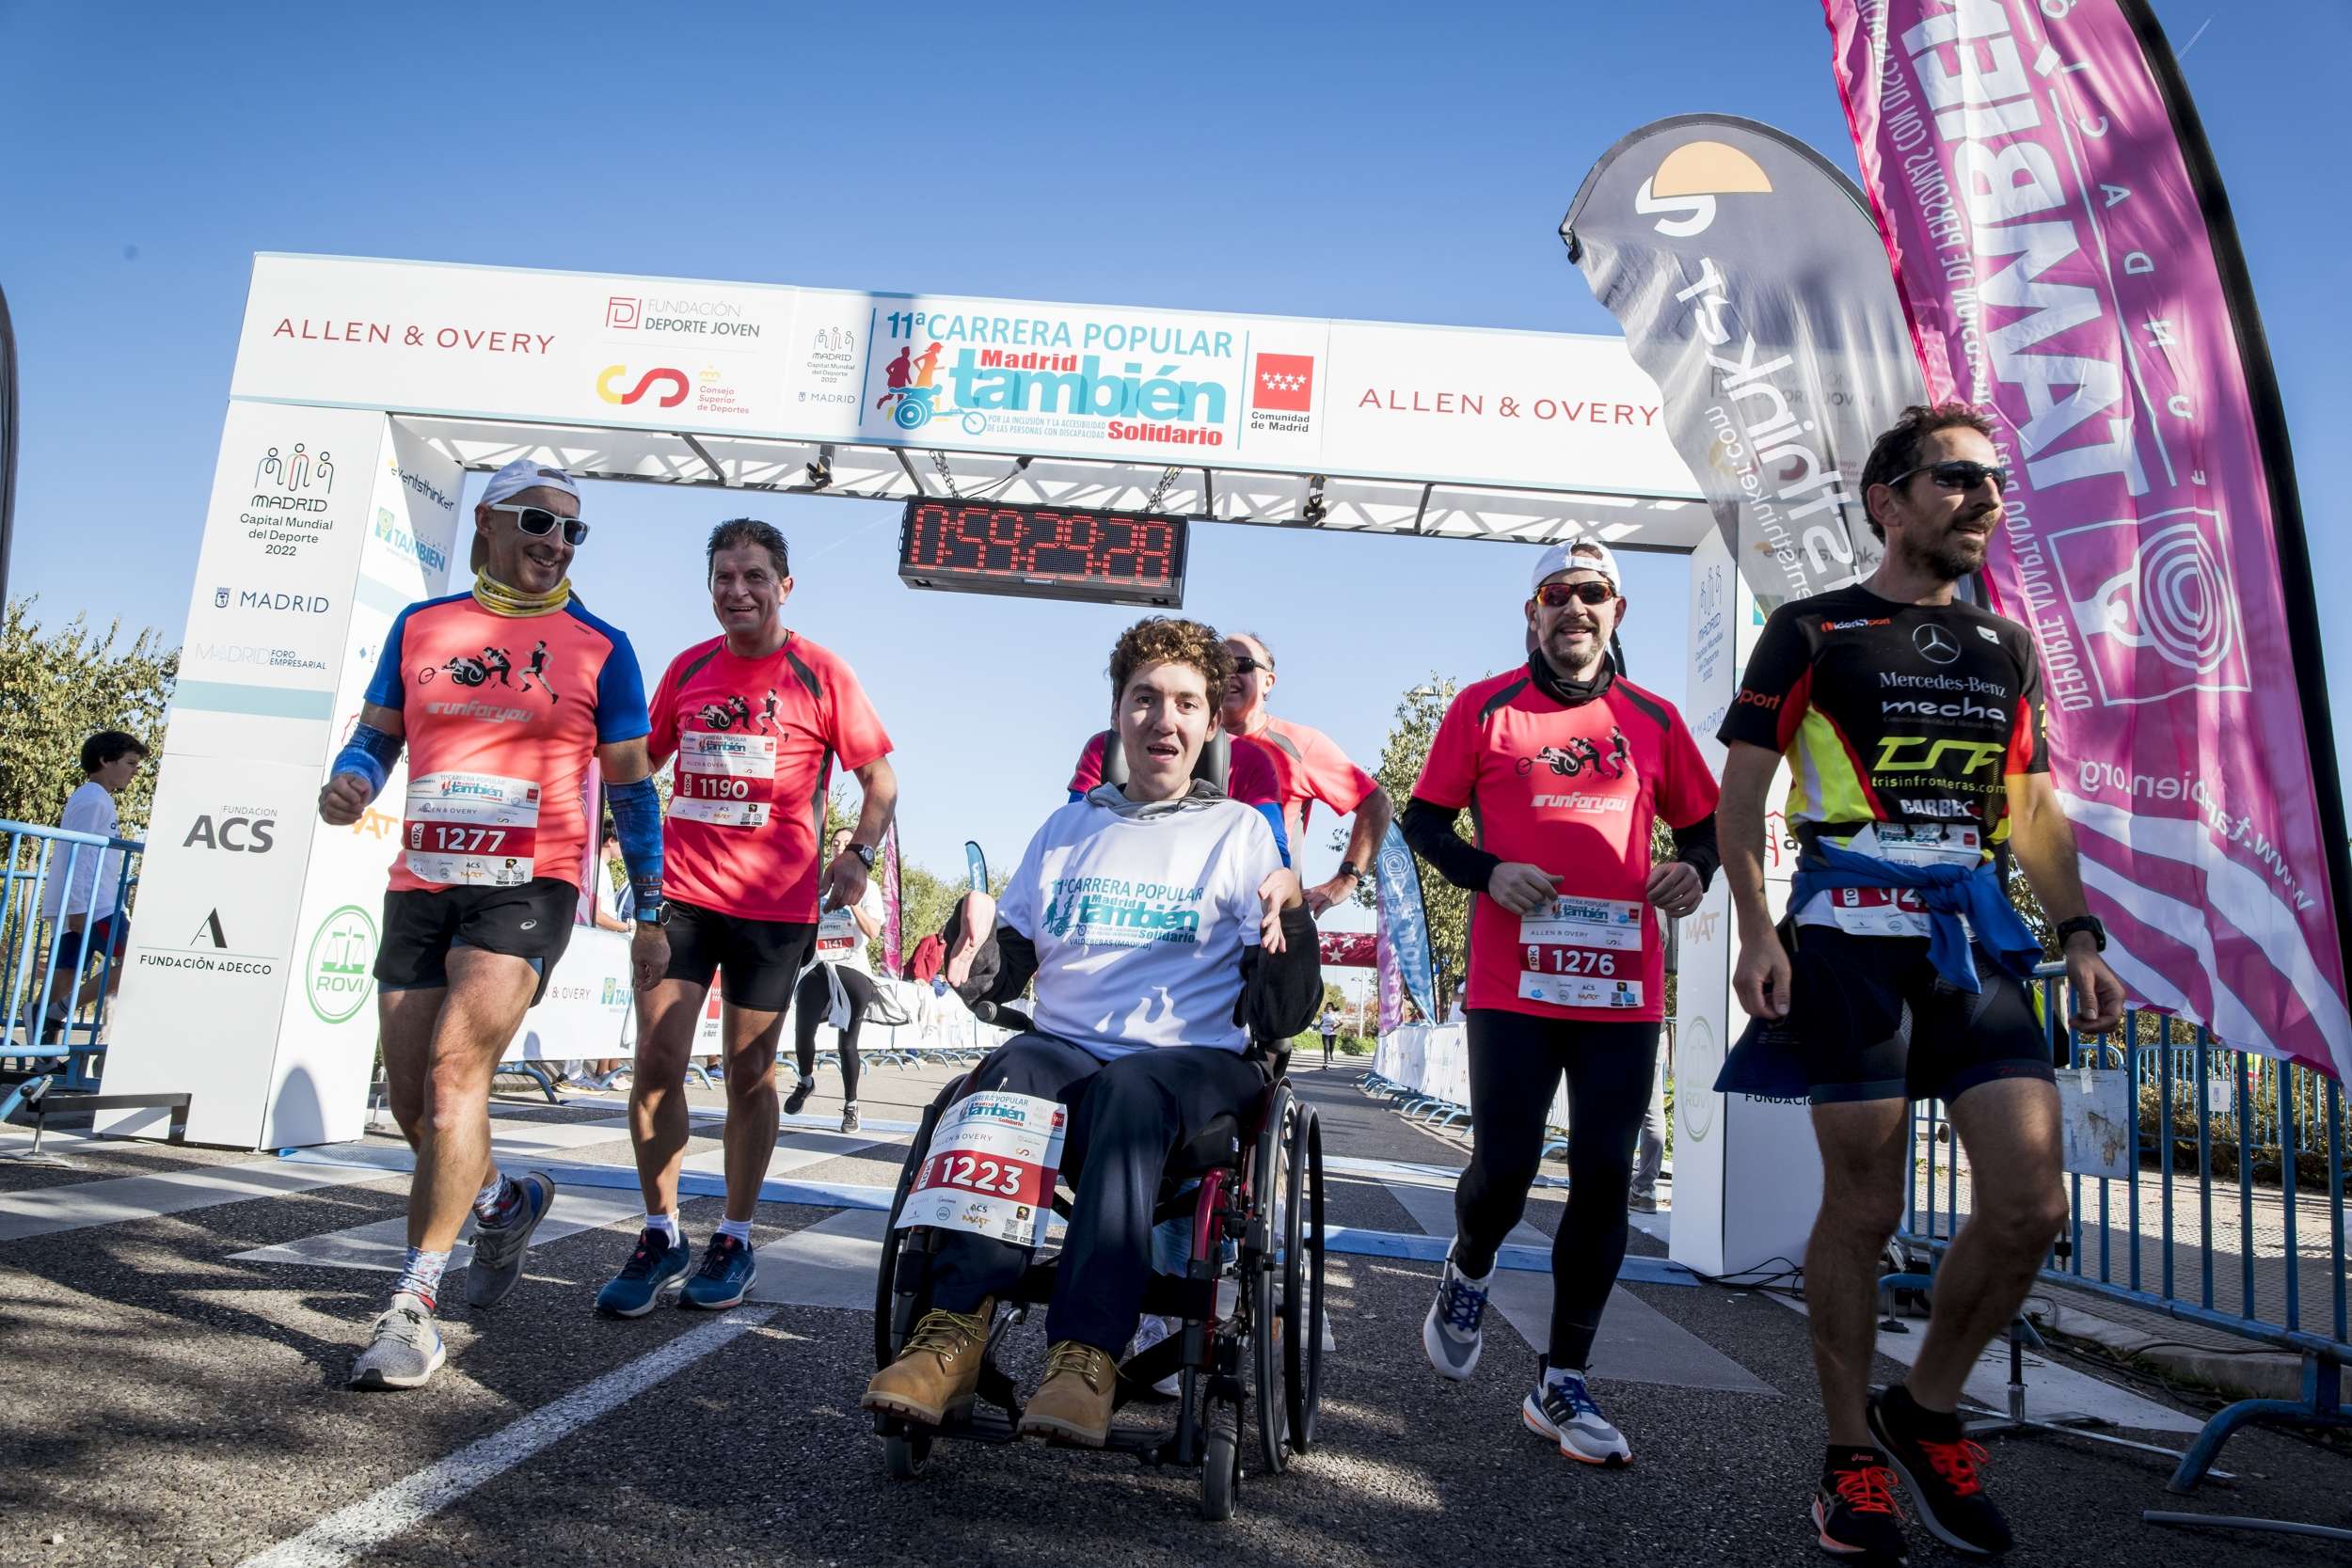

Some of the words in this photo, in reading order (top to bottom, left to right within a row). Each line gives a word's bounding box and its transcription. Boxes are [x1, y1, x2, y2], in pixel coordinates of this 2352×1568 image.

[647, 298, 741, 318] FUNDACIÓN
[273, 318, 390, 344] ALLEN
[404, 325, 425, 347] &
[437, 327, 556, 355] OVERY
[644, 317, 707, 334] DEPORTE
[710, 322, 760, 338] JOVEN
[927, 314, 1073, 348] CARRERA
[1083, 322, 1232, 358] POPULAR
[806, 361, 829, 371] Capital
[980, 348, 1078, 372] Madrid
[699, 386, 735, 396] Consejo
[948, 347, 1227, 424] también
[698, 394, 736, 404] Superior
[811, 392, 856, 404] MADRID
[1358, 388, 1484, 416] ALLEN
[1499, 396, 1521, 419] &
[1533, 398, 1660, 427] OVERY
[709, 404, 750, 414] Deportes
[1250, 411, 1311, 424] Comunidad
[989, 415, 1001, 423] POR
[1011, 415, 1044, 426] INCLUSIÓN
[1060, 419, 1106, 430] ACCESIBILIDAD
[1009, 425, 1042, 436] PERSONAS
[1043, 427, 1057, 436] CON
[1059, 428, 1105, 439] DISCAPACIDAD
[1249, 420, 1263, 432] de
[1267, 421, 1310, 434] Madrid
[1107, 420, 1223, 447] Solidario
[389, 466, 454, 512] eventsthinker
[250, 493, 328, 513] MADRID
[239, 513, 283, 528] Capital
[285, 515, 333, 531] Mundial
[248, 528, 267, 540] del
[269, 530, 319, 545] Deporte
[265, 543, 297, 557] 2022
[393, 528, 446, 573] TAMBIÉN
[240, 589, 329, 614] MADRID
[271, 648, 296, 659] FORO
[269, 657, 326, 671] EMPRESARIAL
[1879, 672, 2007, 699] Mercedes-Benz
[1882, 697, 2007, 722] mecha
[1696, 706, 1726, 741] MADRID
[452, 781, 504, 799] también
[476, 776, 506, 786] POPULAR
[700, 778, 749, 800] 1190
[1871, 775, 2008, 795] trisinfronteras.com
[183, 815, 276, 854] ACS
[413, 826, 422, 846] 10K
[436, 827, 506, 853] 1277
[1067, 878, 1131, 897] CARRERA
[1136, 882, 1205, 902] POPULAR
[1091, 895, 1136, 909] Madrid
[1584, 900, 1611, 909] POPULAR
[1077, 895, 1200, 932] también
[1563, 904, 1609, 920] también
[1137, 928, 1197, 943] Solidario
[1685, 911, 1721, 944] MAT
[822, 939, 844, 950] 1141
[1069, 938, 1114, 947] VALDEBEBAS
[1114, 939, 1152, 952] (MADRID)
[139, 954, 215, 971] FUNDACIÓN
[217, 960, 272, 976] ADECCO
[1530, 949, 1538, 967] 10K
[1551, 949, 1615, 975] 1276
[316, 975, 364, 993] ROVI
[562, 986, 591, 1000] OVERY
[997, 1096, 1029, 1107] POPULAR
[1685, 1091, 1710, 1110] ROVI
[968, 1102, 1025, 1122] también
[997, 1117, 1024, 1128] Solidario
[961, 1132, 993, 1142] OVERY
[919, 1162, 933, 1185] 10K
[942, 1156, 1023, 1196] 1223
